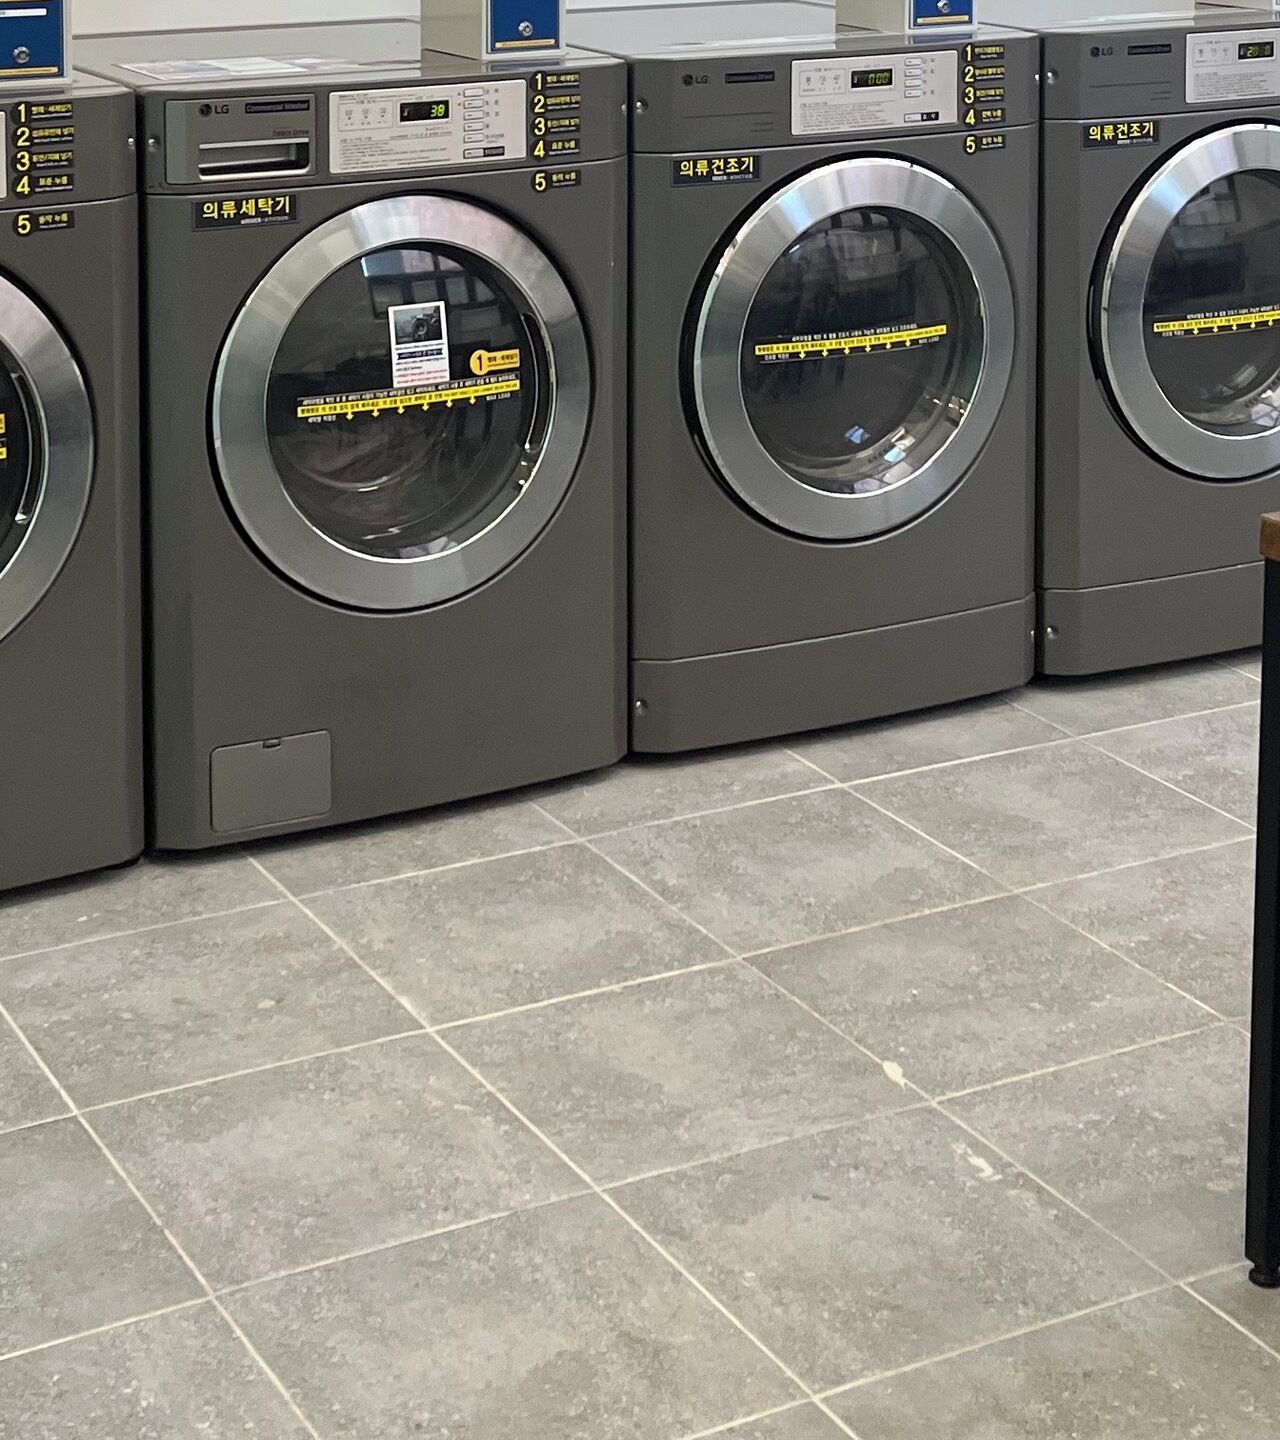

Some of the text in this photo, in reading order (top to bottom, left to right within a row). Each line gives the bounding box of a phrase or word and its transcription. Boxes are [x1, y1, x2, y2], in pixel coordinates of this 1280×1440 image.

[966, 44, 971, 61] 1
[1102, 48, 1113, 56] LG
[535, 74, 543, 90] 1
[695, 75, 708, 84] LG
[964, 66, 974, 82] 2
[964, 87, 974, 103] 3
[17, 103, 26, 122] 1
[214, 104, 229, 114] LG
[534, 95, 545, 113] 2
[965, 109, 975, 125] 4
[535, 118, 545, 135] 3
[16, 127, 30, 146] 2
[966, 136, 976, 153] 5
[534, 140, 545, 158] 4
[16, 151, 30, 171] 3
[16, 175, 30, 194] 4
[535, 173, 546, 190] 5
[17, 214, 31, 234] 5
[477, 354, 483, 371] 1
